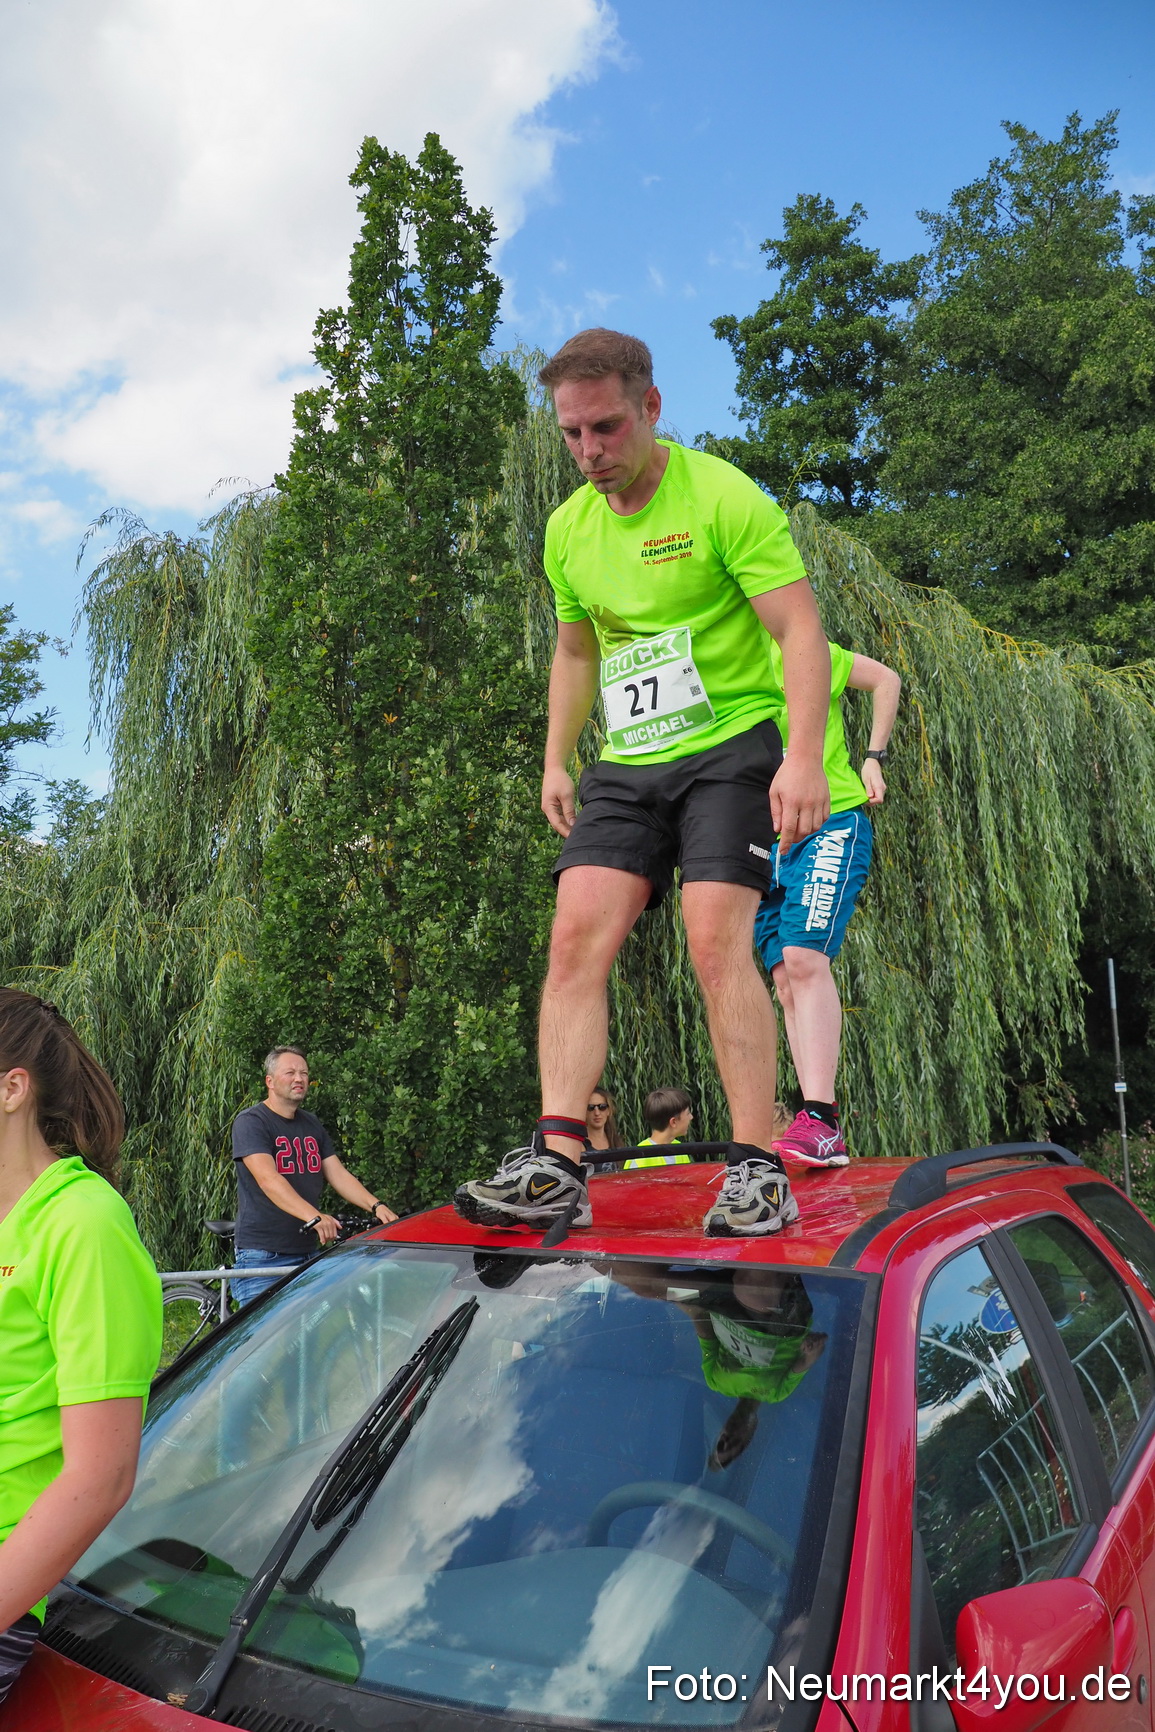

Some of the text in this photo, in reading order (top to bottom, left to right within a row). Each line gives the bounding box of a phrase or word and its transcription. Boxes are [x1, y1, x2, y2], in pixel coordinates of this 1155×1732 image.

[641, 540, 694, 557] ELEMENTELAUF
[643, 531, 690, 547] NEUMARKTER
[652, 554, 679, 566] September
[606, 633, 680, 683] BOCK
[624, 676, 658, 717] 27
[622, 714, 694, 746] MICHAEL
[275, 1136, 321, 1174] 218
